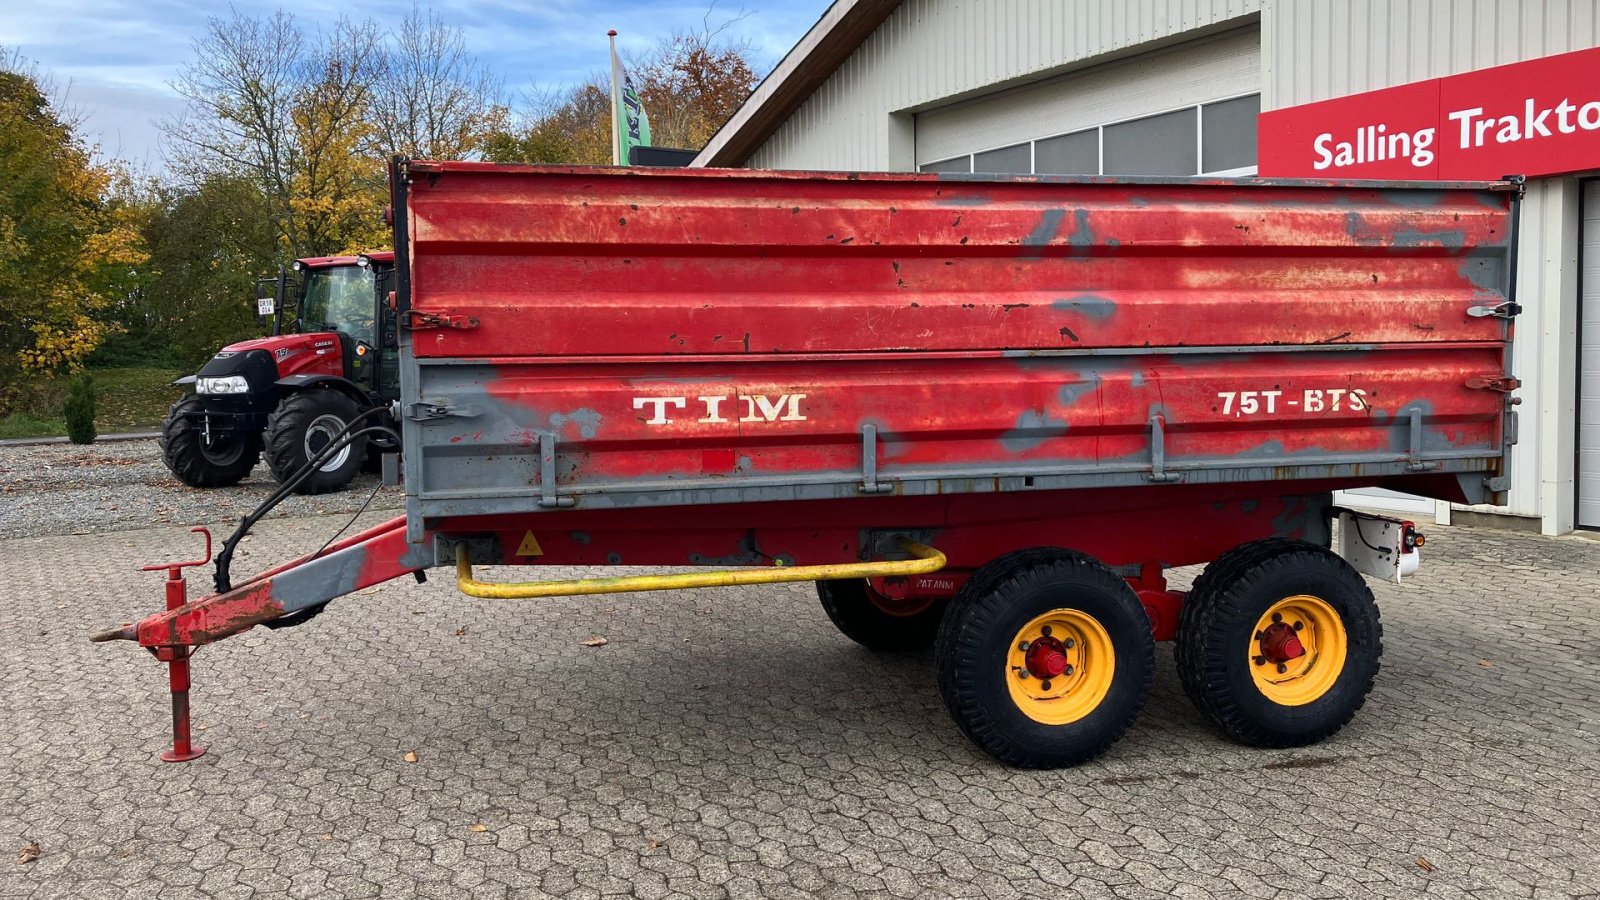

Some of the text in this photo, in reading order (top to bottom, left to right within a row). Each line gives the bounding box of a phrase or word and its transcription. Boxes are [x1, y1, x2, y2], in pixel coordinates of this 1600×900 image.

[1313, 97, 1600, 170] Salling Trakto
[633, 394, 807, 425] TIM
